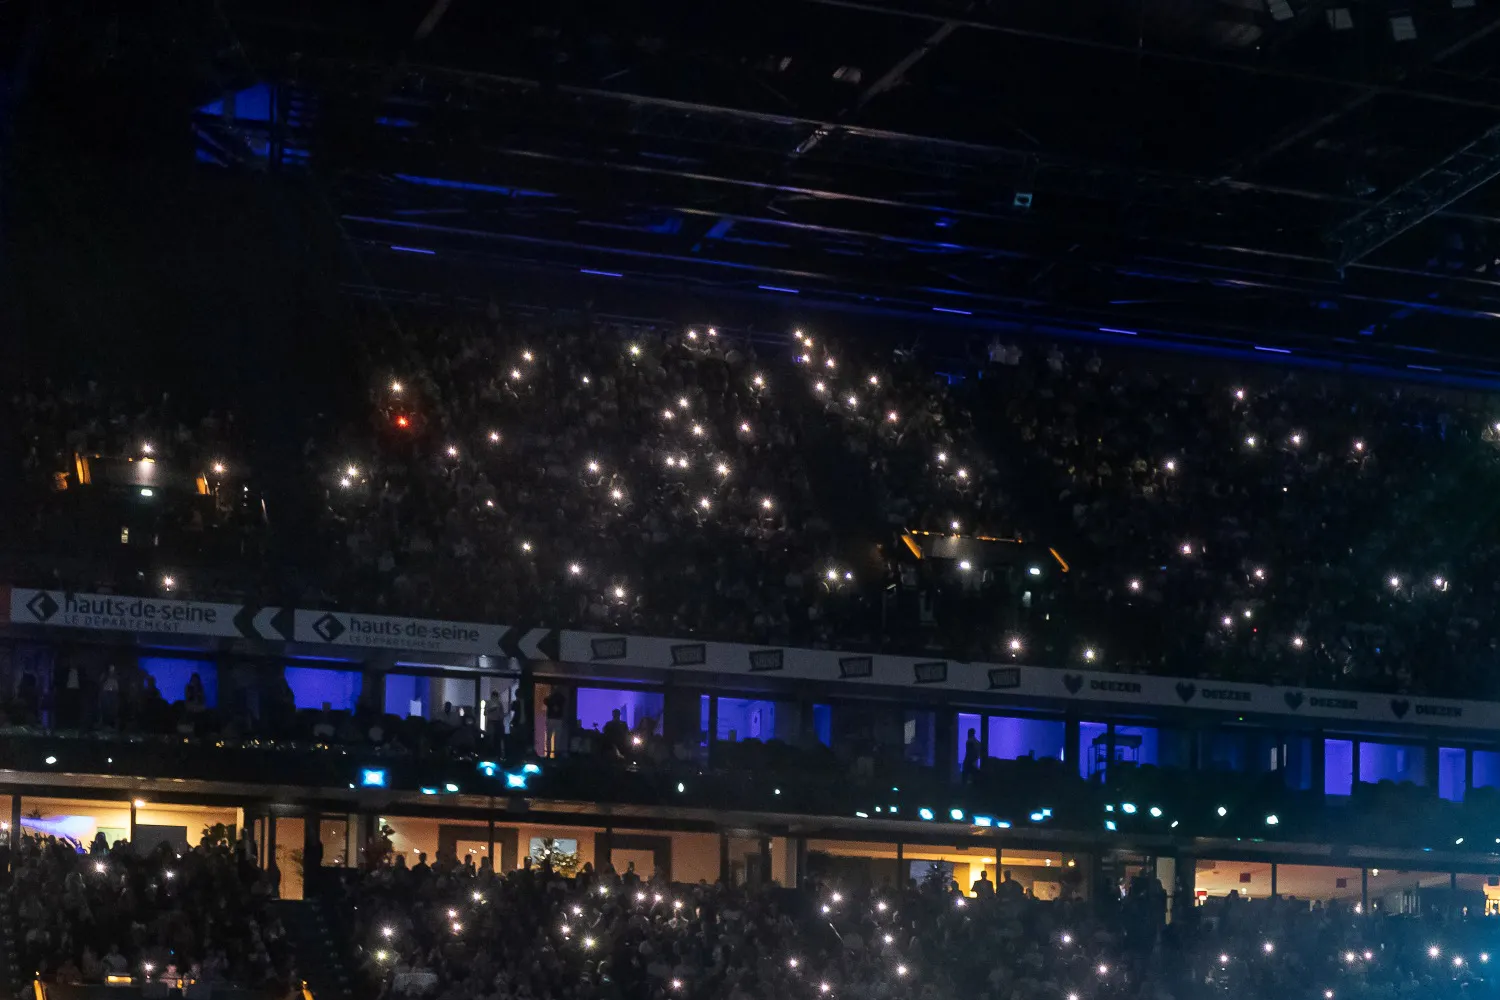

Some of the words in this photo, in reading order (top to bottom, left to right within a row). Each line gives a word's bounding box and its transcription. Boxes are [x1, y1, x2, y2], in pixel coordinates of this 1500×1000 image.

[1090, 680, 1142, 693] DEEZER
[1202, 688, 1252, 702] DEEZER
[1310, 696, 1358, 710] DEEZER
